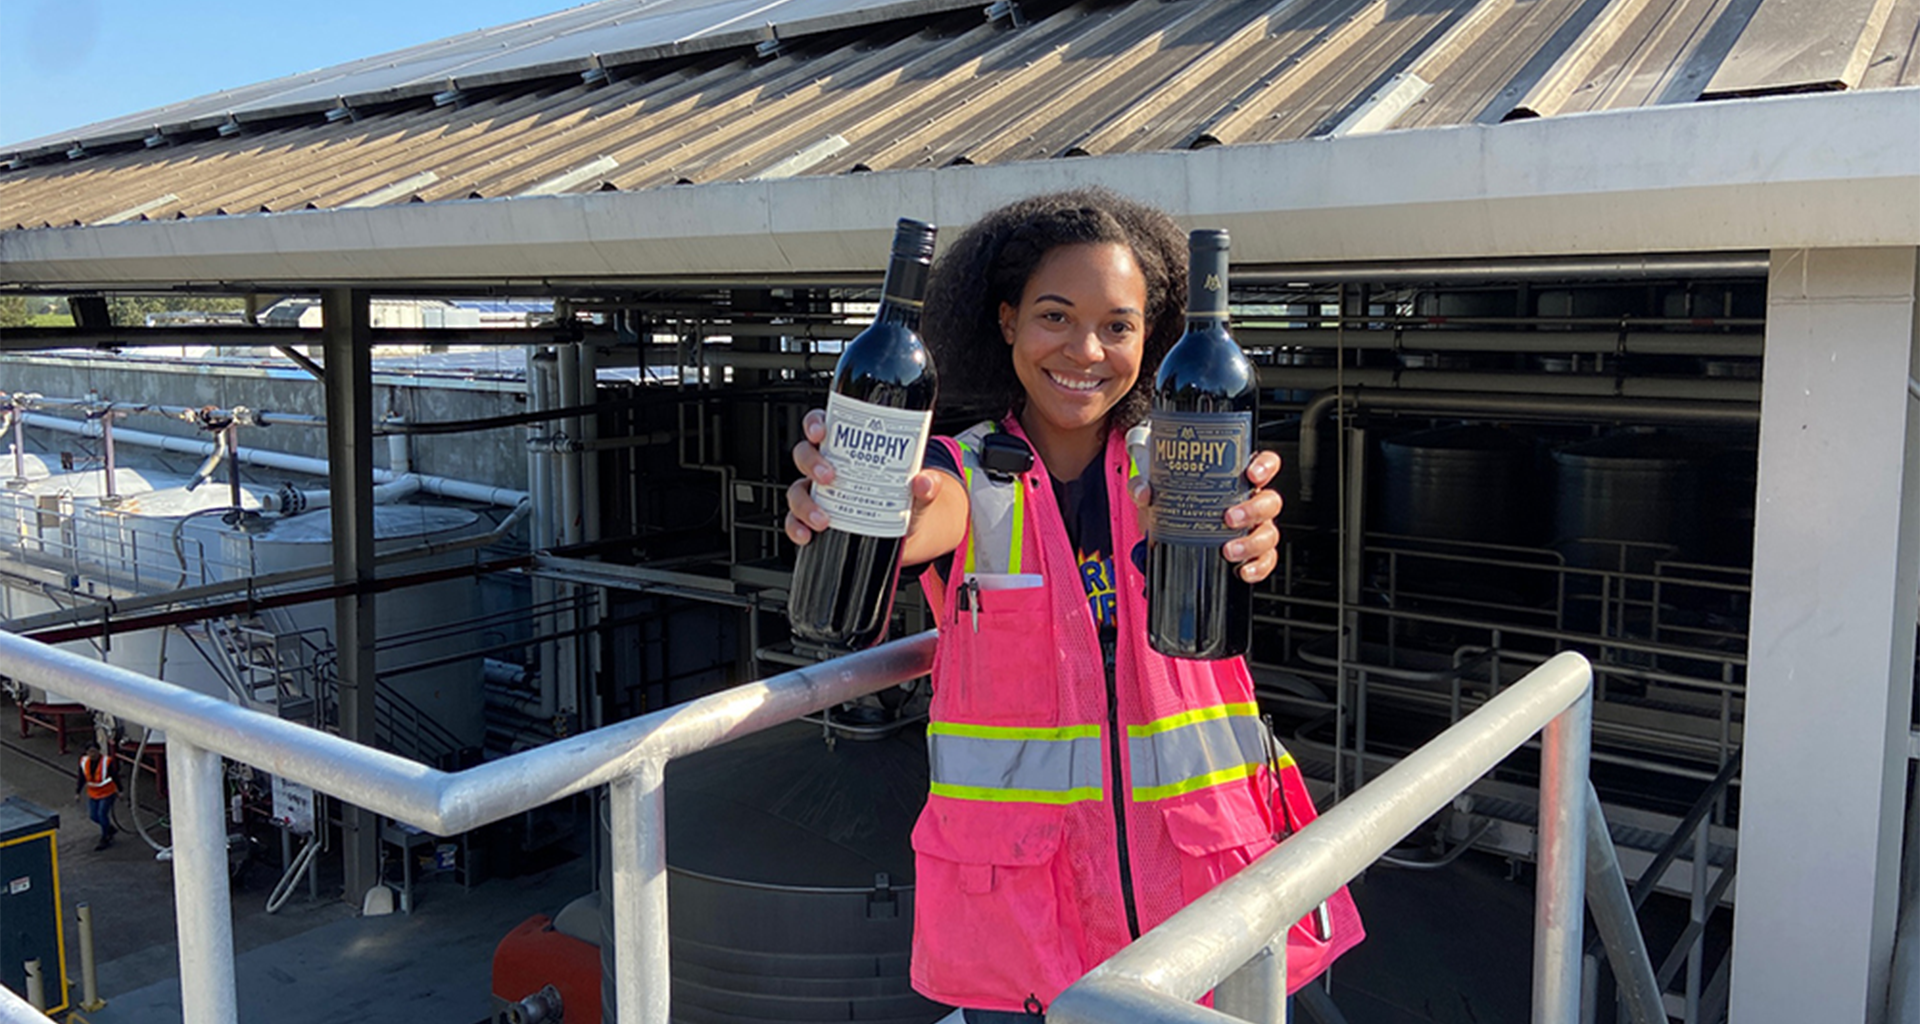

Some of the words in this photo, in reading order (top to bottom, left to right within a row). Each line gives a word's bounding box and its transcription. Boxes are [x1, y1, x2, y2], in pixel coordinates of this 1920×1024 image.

[834, 424, 909, 461] MURPHY
[850, 450, 886, 466] GOODE
[1155, 438, 1227, 466] MURPHY
[1168, 460, 1205, 472] GOODE
[837, 492, 883, 506] CALIFORNIA
[838, 505, 855, 514] RED
[856, 509, 877, 519] WINE
